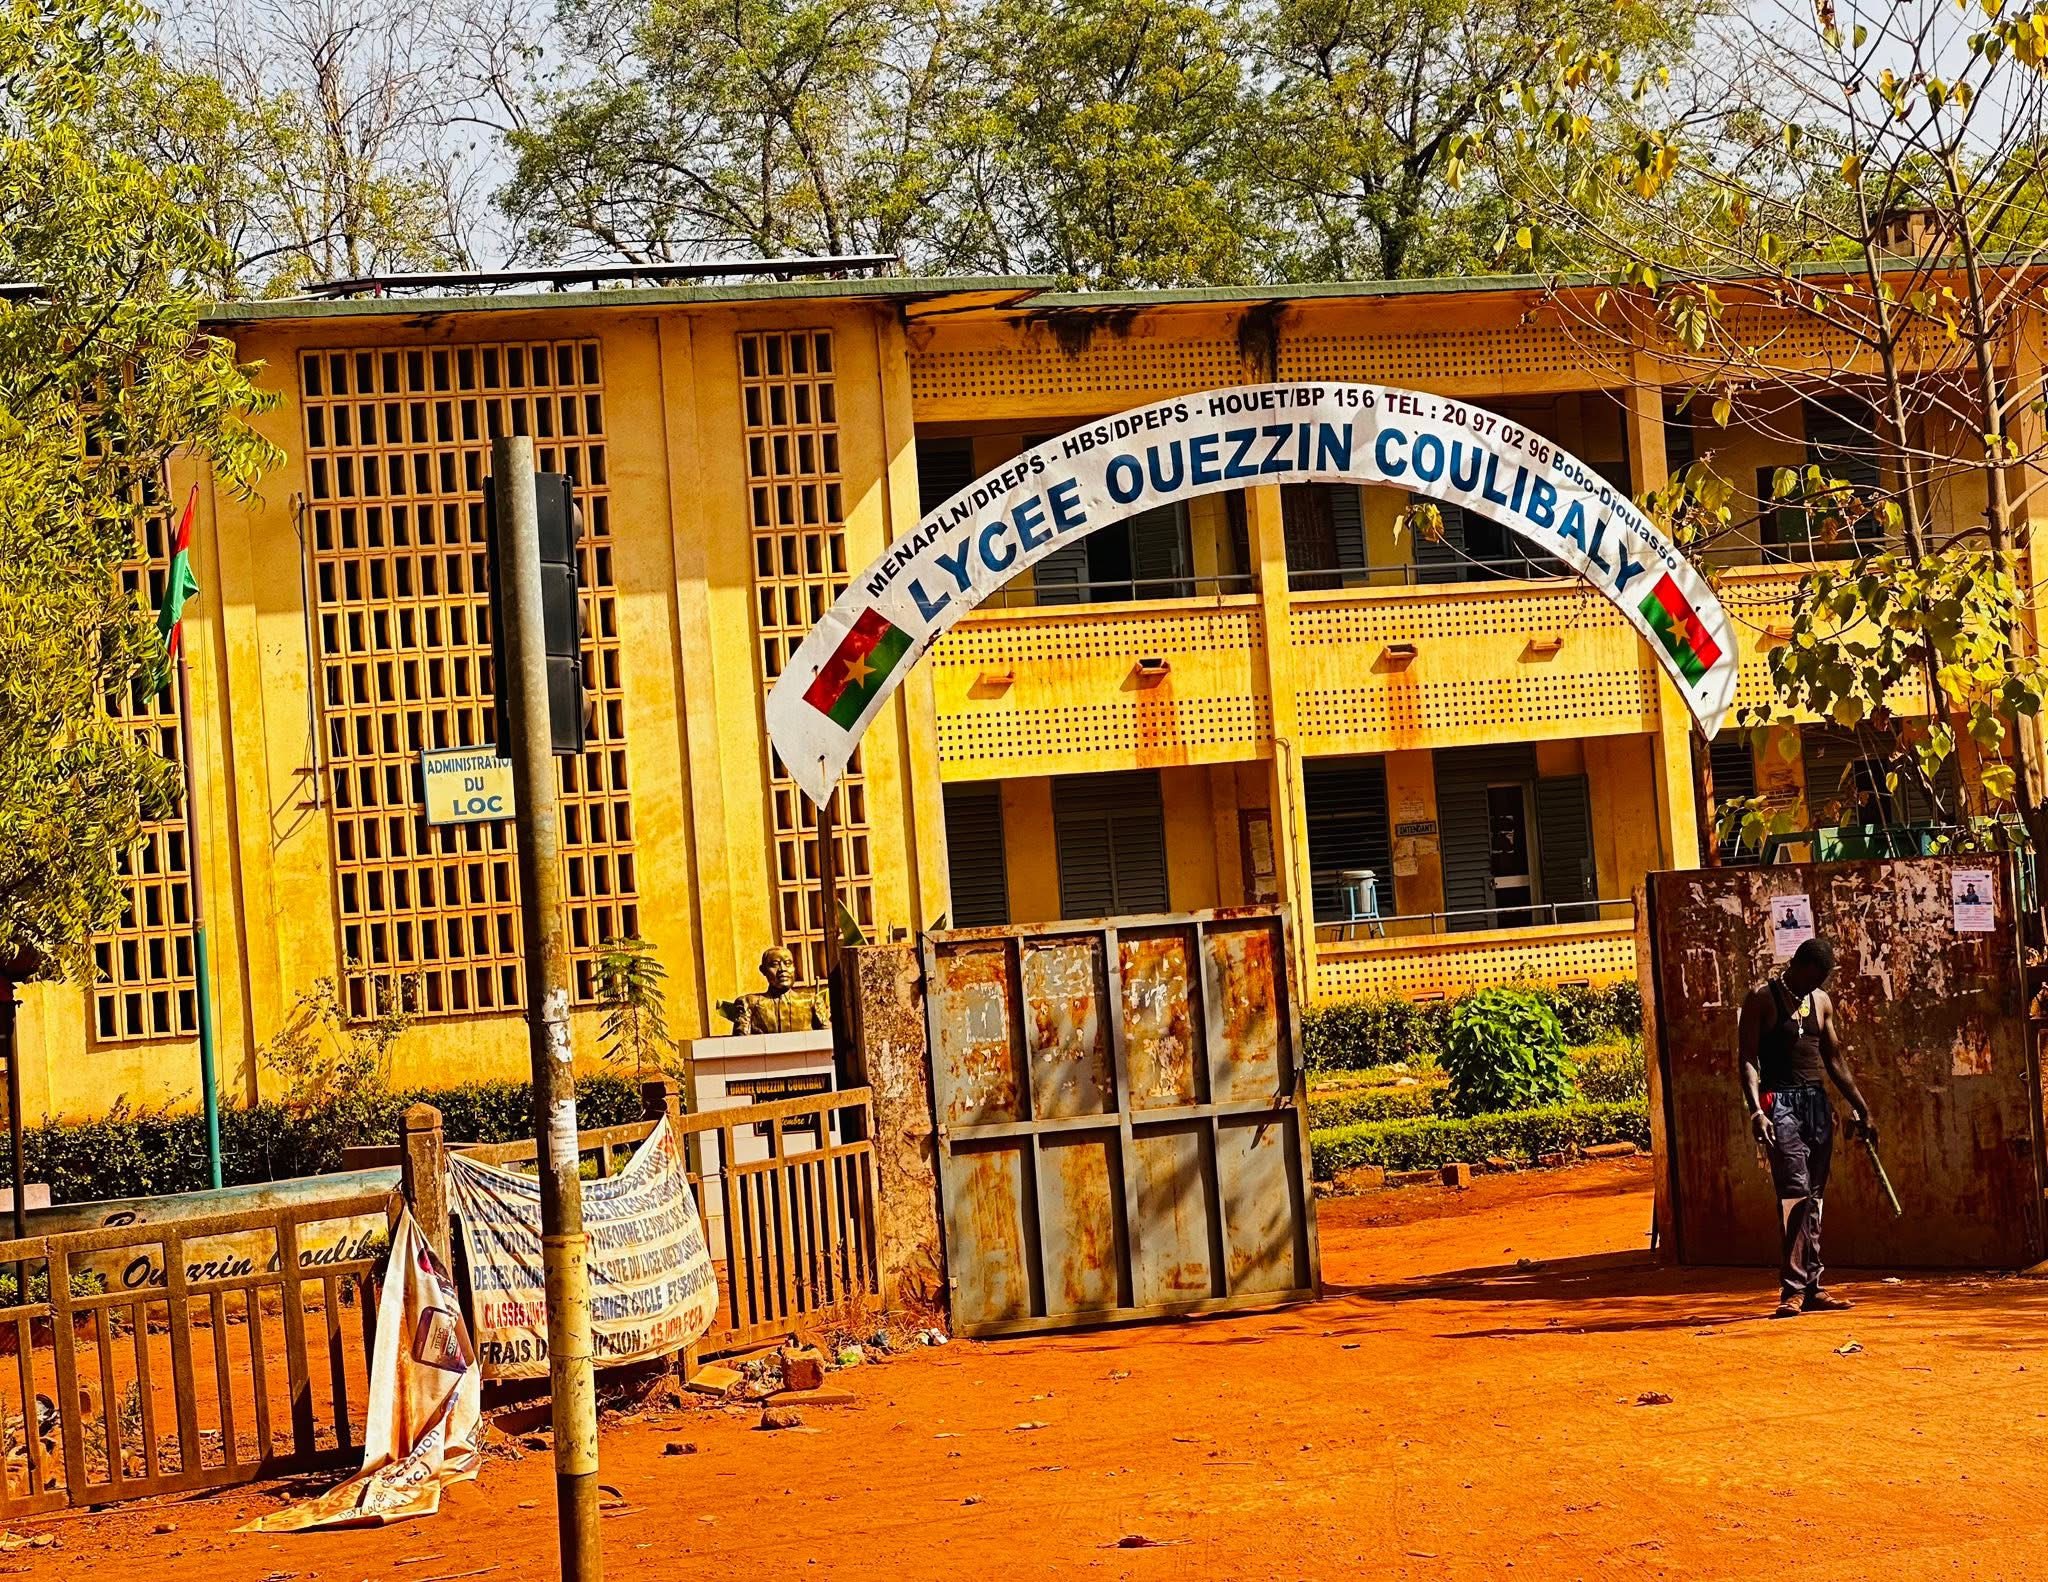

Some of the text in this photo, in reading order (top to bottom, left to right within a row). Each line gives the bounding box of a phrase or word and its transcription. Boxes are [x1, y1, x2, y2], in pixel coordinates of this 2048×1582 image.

[866, 454, 1046, 599] MENAPLN/DREPS
[1061, 403, 1190, 460] HBS/DPEPS
[1209, 387, 1325, 418] HOUET/BP
[1333, 388, 1375, 409] 156
[1443, 403, 1468, 428] 20
[1472, 412, 1497, 433] 97
[1501, 424, 1525, 449] 02
[1529, 437, 1550, 466] 96
[1551, 449, 1678, 571] Bobo-Dioulasso
[907, 422, 1646, 624] LYCEE OUEZZIN COULIBALY
[427, 755, 513, 775] ADMINISTRATIO
[464, 776, 485, 793] DU
[453, 795, 504, 816] LOC
[1399, 824, 1433, 835] INTENDANT
[730, 1082, 755, 1095] DANIEL
[787, 1077, 826, 1091] COULIBALY
[474, 1265, 488, 1290] DE
[489, 1264, 512, 1290] SES
[606, 1257, 629, 1284] SITE
[628, 1256, 641, 1281] DU
[640, 1249, 663, 1277] LYCEE
[484, 1301, 525, 1329] CLASSES
[589, 1294, 629, 1322] EMIER
[629, 1286, 663, 1316] CYCLE
[667, 1280, 679, 1305] ET
[480, 1338, 531, 1365] FRAIS
